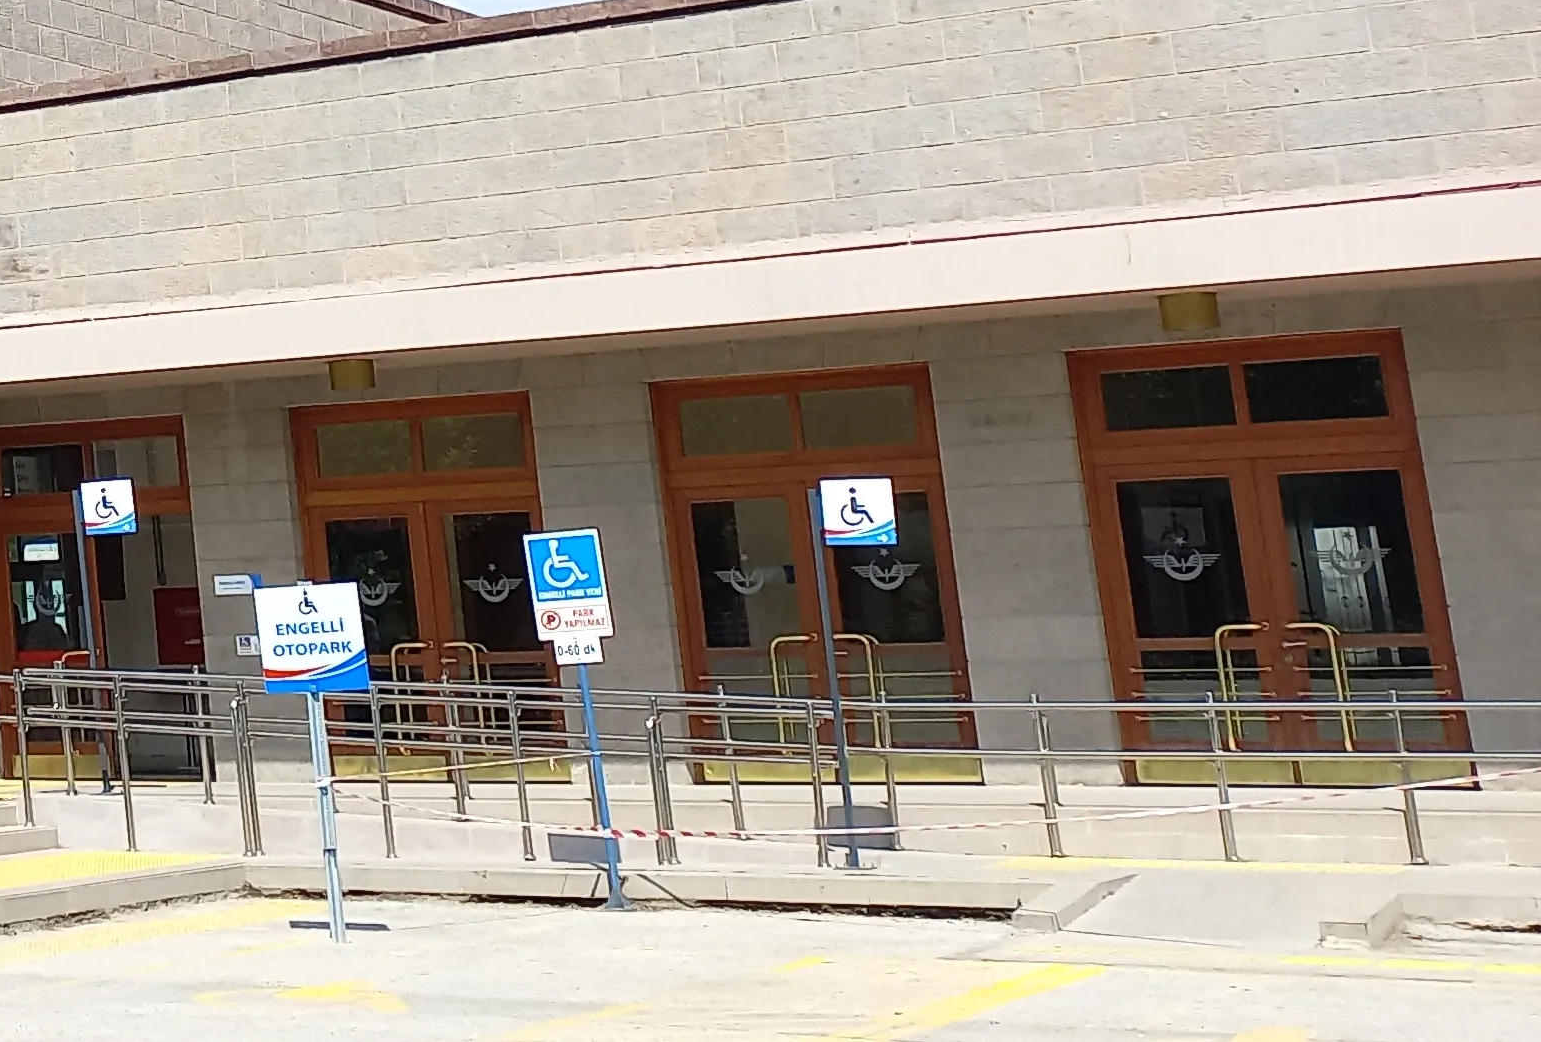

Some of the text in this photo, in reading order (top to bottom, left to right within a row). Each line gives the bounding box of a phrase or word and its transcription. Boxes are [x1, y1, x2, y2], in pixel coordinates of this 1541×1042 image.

[572, 608, 595, 617] PARK
[275, 617, 344, 636] ENGELLİ
[273, 641, 353, 657] OTOPARK
